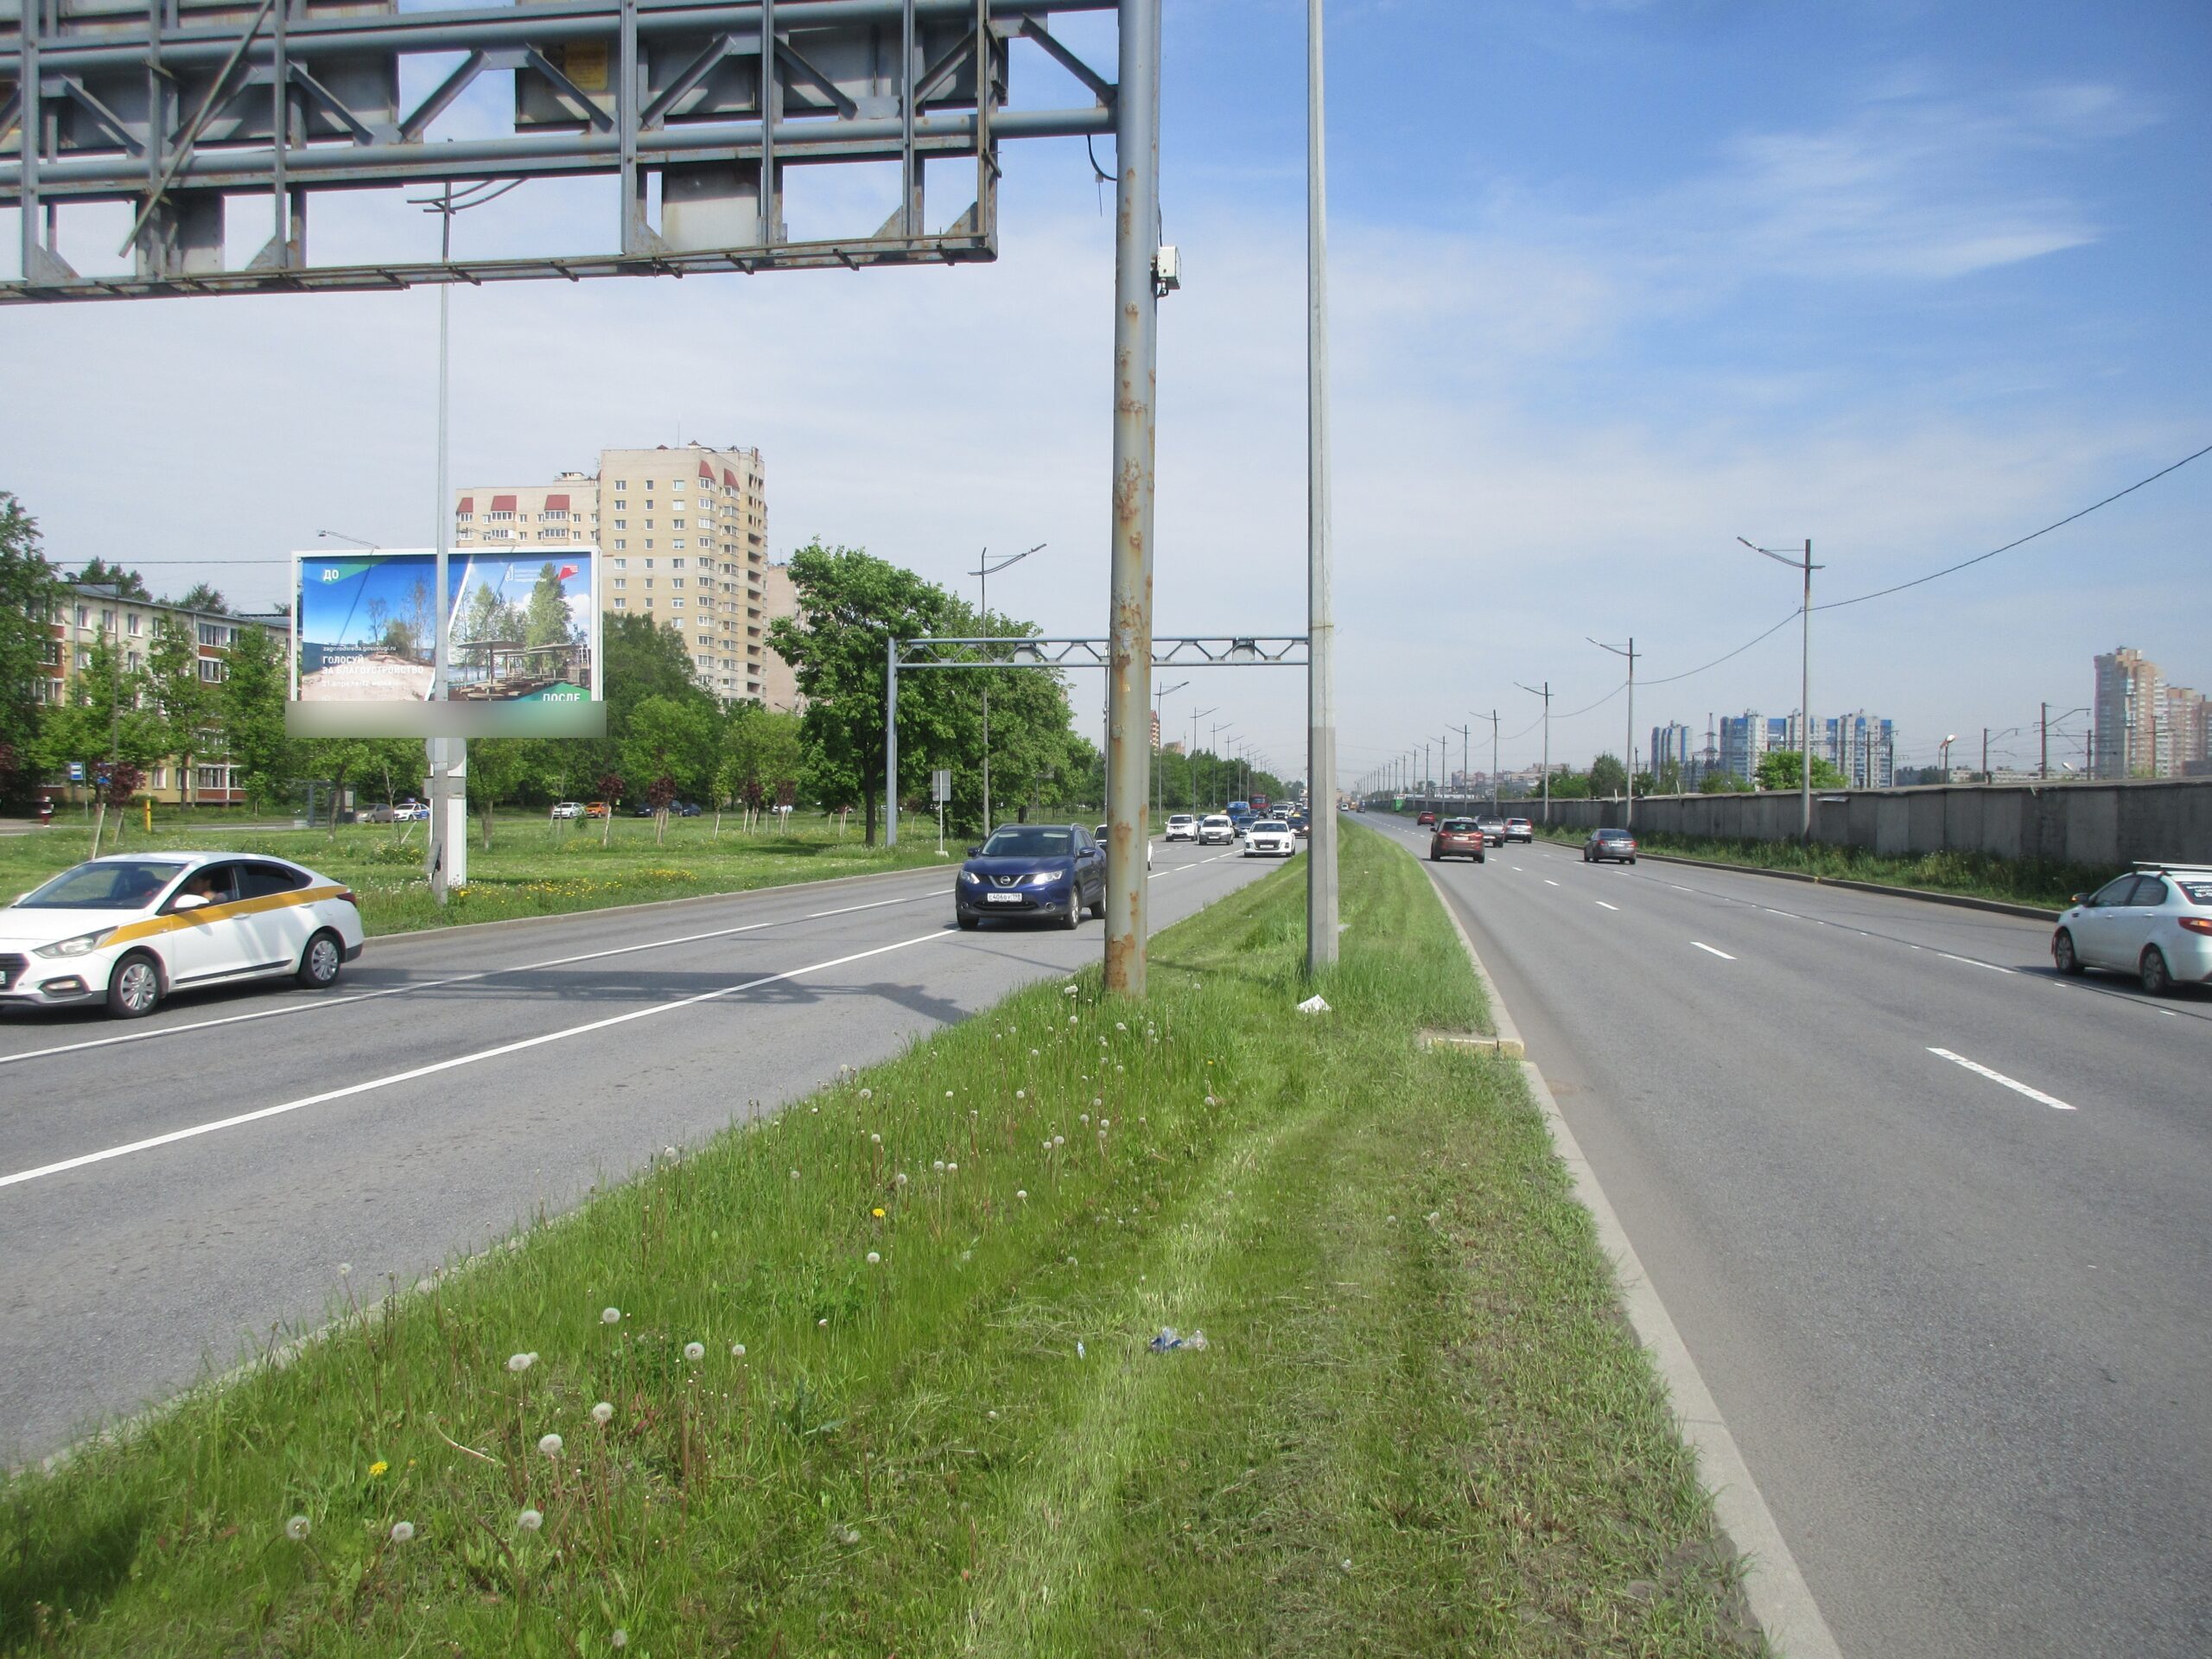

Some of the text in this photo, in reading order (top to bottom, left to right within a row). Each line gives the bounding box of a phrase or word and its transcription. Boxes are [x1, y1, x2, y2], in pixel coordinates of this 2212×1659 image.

[323, 569, 340, 582] ДО
[323, 655, 364, 664] ГОЛОСУЙ
[322, 665, 423, 675] ЗА БЛАГОУСТРОЙСТВО
